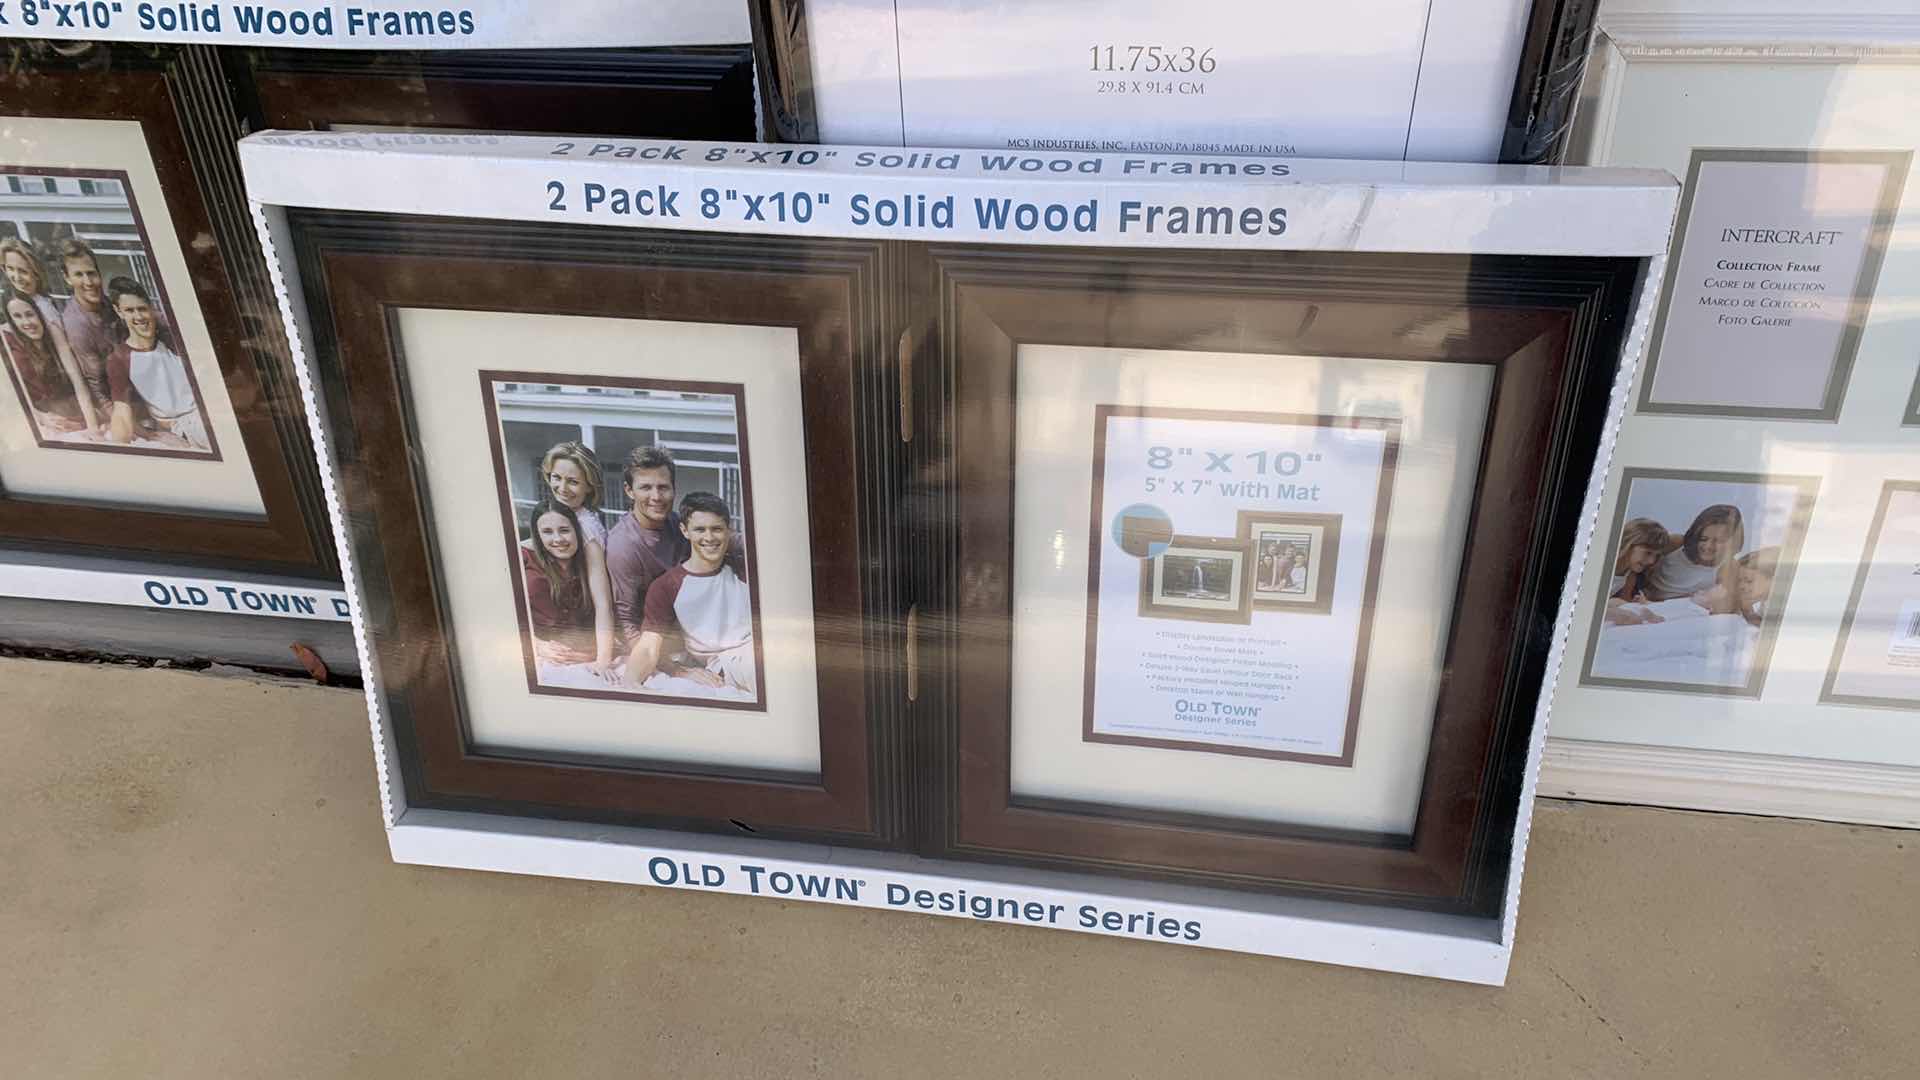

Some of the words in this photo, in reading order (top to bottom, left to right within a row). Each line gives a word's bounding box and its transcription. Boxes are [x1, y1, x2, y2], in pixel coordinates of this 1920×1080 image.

[20, 0, 122, 29] 8"x10"
[137, 2, 221, 32] Solid
[233, 6, 333, 35] Wood
[347, 8, 474, 35] Frames
[1088, 44, 1216, 74] 11.75x36
[1097, 80, 1126, 94] 29.8
[1145, 81, 1173, 95] 91.4
[1178, 82, 1205, 95] CM
[550, 142, 575, 155] 2
[588, 143, 687, 161] Pack
[704, 147, 838, 166] 8"x10"
[854, 150, 960, 171] Solid
[980, 155, 1102, 174] Wood
[1123, 158, 1290, 176] Frames
[1007, 139, 1030, 148] MCS
[1192, 144, 1220, 152] 18045
[1222, 144, 1255, 153] MADE
[1258, 145, 1272, 153] IN
[1275, 145, 1296, 154] USA
[546, 180, 567, 211] 2
[583, 182, 680, 217] Pack
[699, 188, 830, 223] 8"x10"
[851, 193, 954, 229] Solid
[974, 197, 1098, 233] Wood
[1118, 200, 1287, 236] Frames
[1721, 228, 1841, 245] INTERCRAFT
[1219, 481, 1269, 499] with
[1276, 482, 1320, 501] Mat
[143, 581, 209, 606] OLD
[1175, 699, 1208, 713] OLD
[647, 856, 725, 887] OLD
[886, 882, 1064, 925] Designer
[1077, 905, 1201, 941] Series
